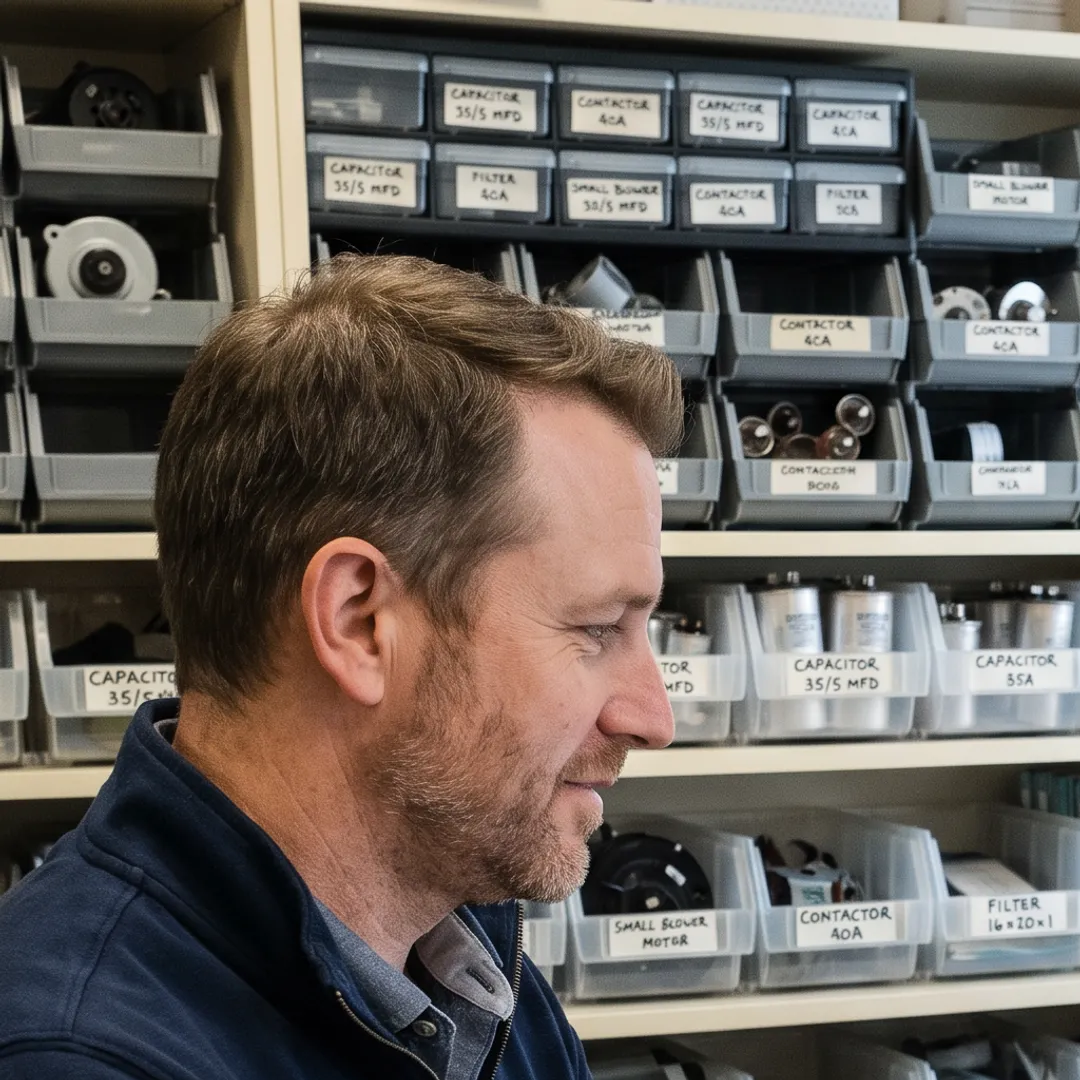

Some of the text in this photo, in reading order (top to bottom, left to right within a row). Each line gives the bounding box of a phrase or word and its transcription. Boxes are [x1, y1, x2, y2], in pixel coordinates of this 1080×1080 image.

[451, 87, 521, 104] CAPACITOR
[330, 162, 403, 179] CAPACITOR
[779, 318, 855, 332] CONTACTOR
[794, 658, 880, 673] CAPACITOR
[975, 654, 1057, 669] CAPACITOR
[805, 677, 880, 693] 35/5 MFD
[988, 896, 1042, 913] FILTER
[800, 906, 893, 925] CONTACTOR
[614, 918, 657, 934] SMALL
